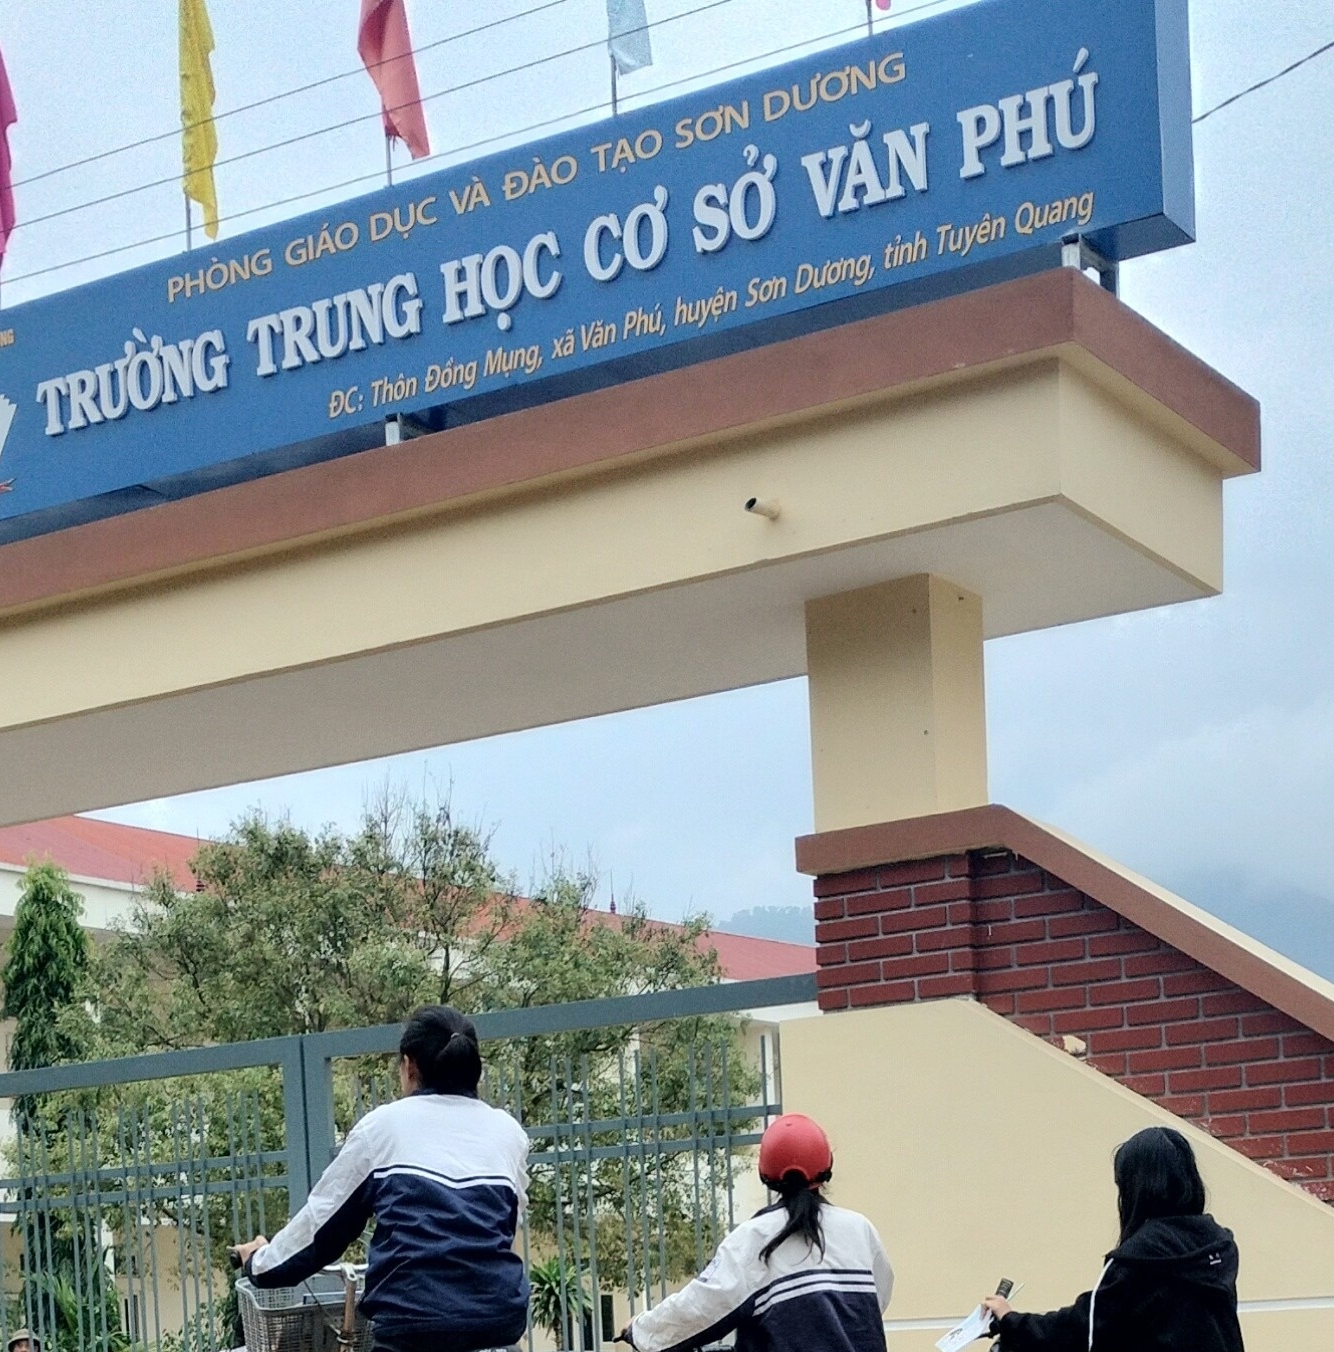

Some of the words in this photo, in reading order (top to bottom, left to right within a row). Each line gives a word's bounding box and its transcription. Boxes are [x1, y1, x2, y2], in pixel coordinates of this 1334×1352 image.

[36, 326, 231, 437] TRƯỜNG
[246, 271, 424, 377] TRUNG
[440, 230, 564, 331] HỌC
[584, 184, 669, 282] CƠ
[692, 143, 779, 253] SỞ
[800, 118, 931, 218] VĂN
[956, 47, 1100, 180] PHÚ
[167, 248, 274, 303] PHÒNG
[284, 222, 360, 267] GIÁO
[369, 196, 438, 242] DỤC
[449, 175, 492, 216] VÀ
[502, 155, 579, 201] ĐÀO
[591, 128, 664, 175] TẠO
[674, 99, 751, 150] SƠN
[763, 51, 907, 124] DƯƠNG
[328, 386, 364, 420] ĐC:
[371, 373, 418, 408] Thôn
[424, 356, 478, 393] Đồng
[483, 344, 544, 380] Mụng,
[551, 327, 576, 360] xã
[580, 320, 617, 351] Văn
[622, 302, 668, 340] Phú,
[673, 286, 739, 330] huyện
[744, 274, 788, 308] Sơn
[794, 252, 876, 296] Dương,
[882, 233, 929, 270] tỉnh
[937, 212, 1006, 257] Tuyên
[1014, 191, 1096, 236] Quang
